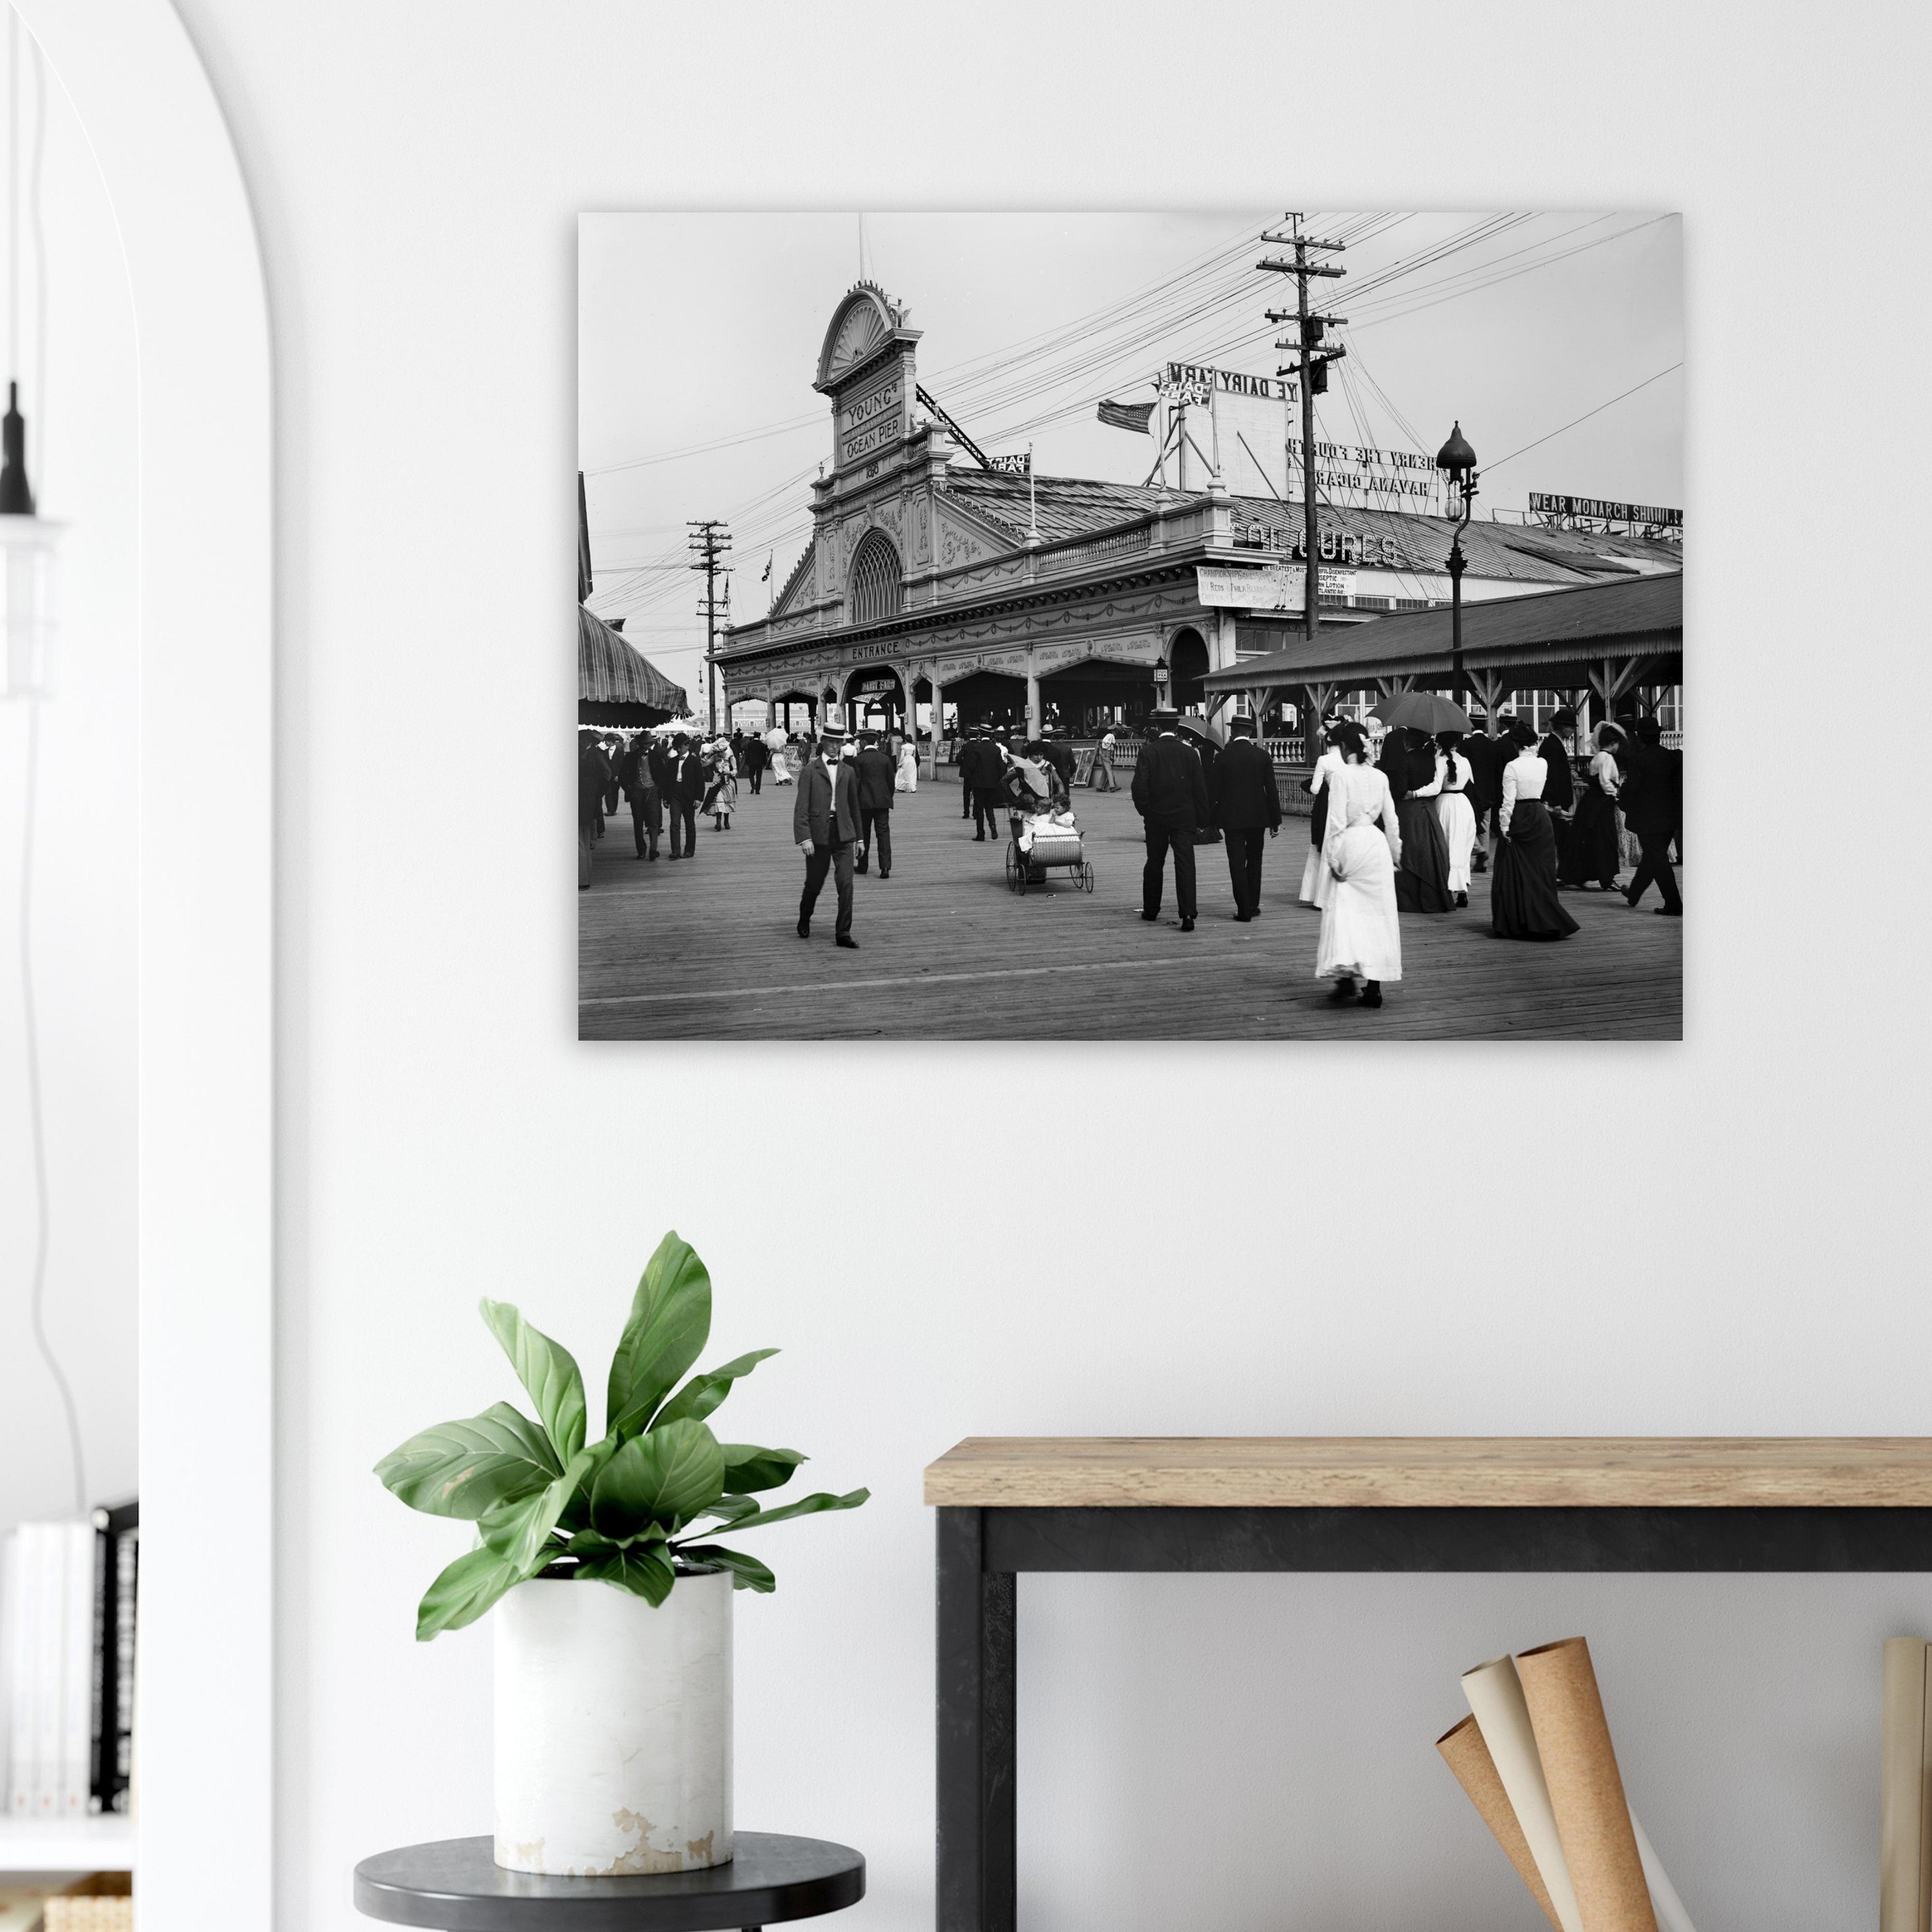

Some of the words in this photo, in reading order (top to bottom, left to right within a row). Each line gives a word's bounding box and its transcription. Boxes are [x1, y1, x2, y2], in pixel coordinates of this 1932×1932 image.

[849, 383, 897, 426] YOUNG'S
[847, 432, 875, 458] OCEAN
[879, 419, 898, 442] PIER
[1531, 493, 1566, 513] WEAR
[1572, 497, 1627, 520] MONARCH
[1299, 528, 1397, 564] CURES
[1200, 568, 1238, 578] CHAMPIONSHIP
[1238, 569, 1256, 580] GAMES
